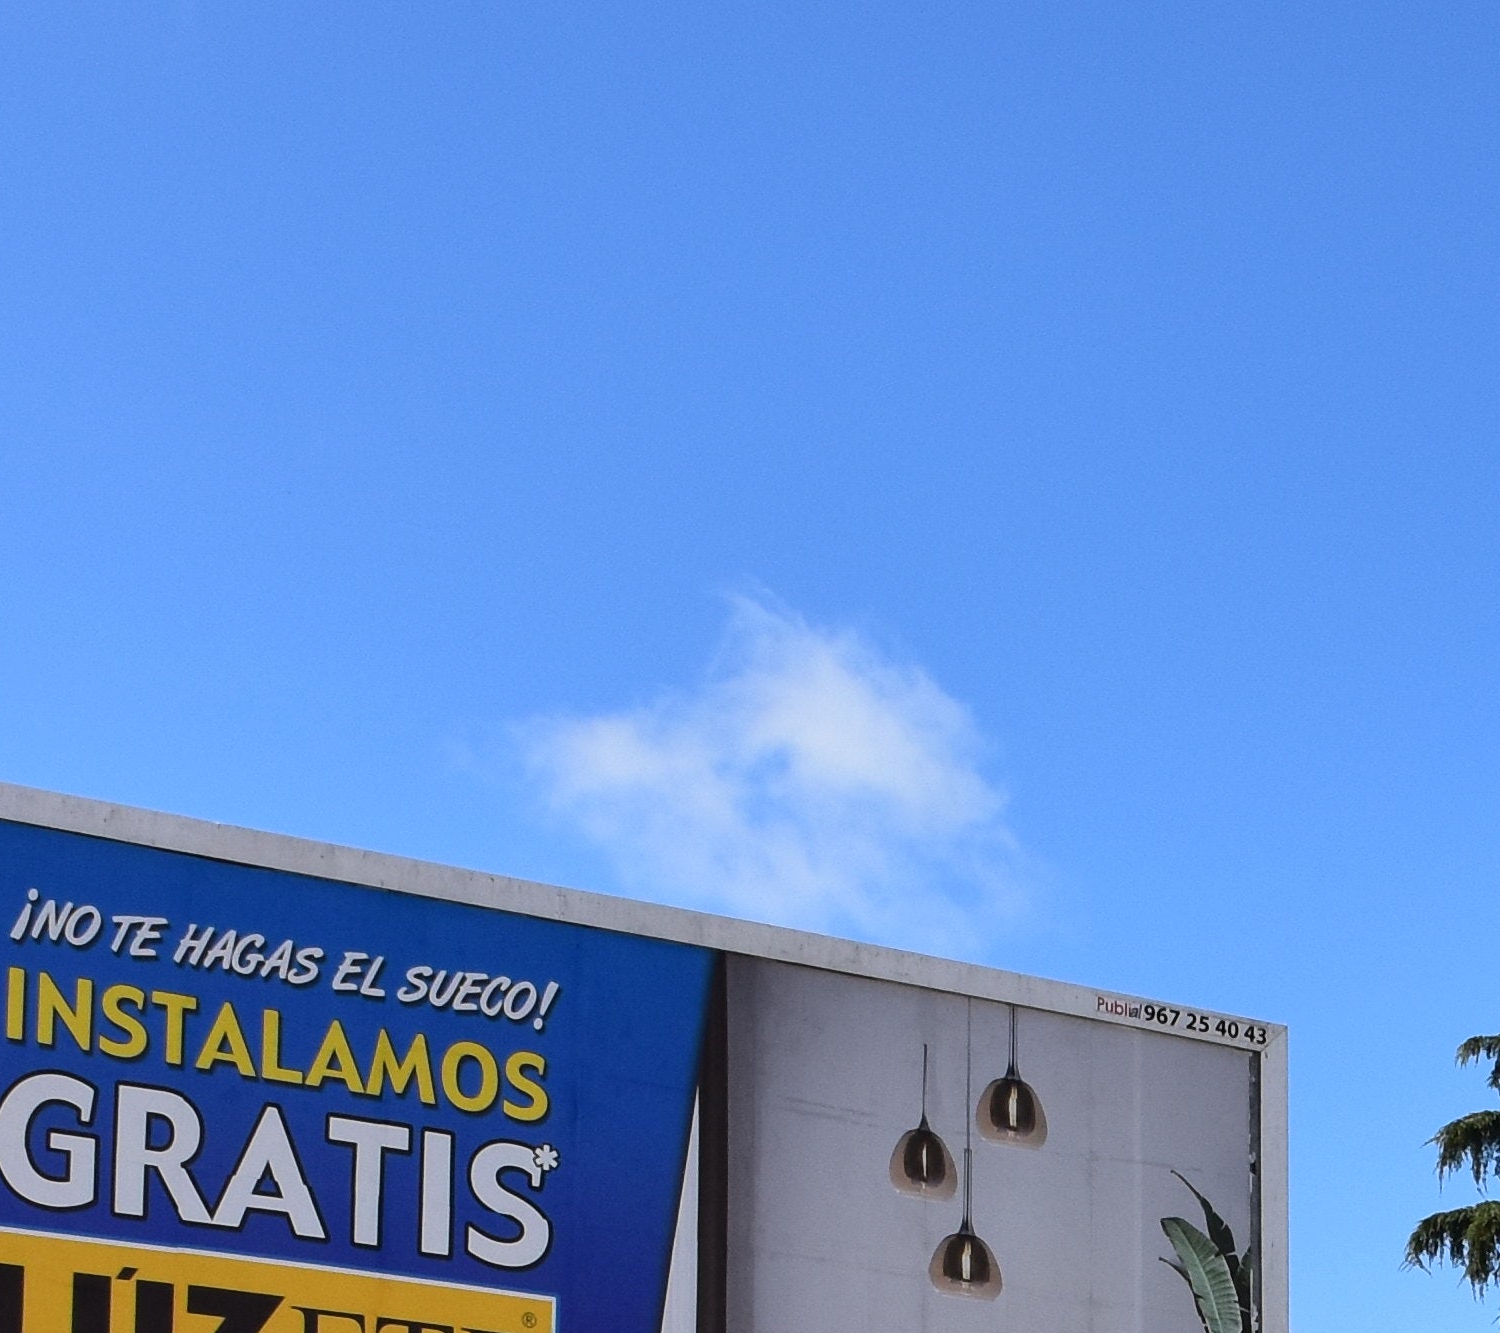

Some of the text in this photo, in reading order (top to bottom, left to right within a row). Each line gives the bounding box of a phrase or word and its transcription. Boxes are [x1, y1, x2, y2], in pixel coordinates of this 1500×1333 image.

[9, 886, 561, 1031] ¡NO TE HAGAS EL SUECO!
[1144, 1004, 1180, 1027] 967
[1186, 1012, 1210, 1033] 25
[1215, 1019, 1239, 1039] 40
[1244, 1025, 1268, 1045] 43
[4, 966, 550, 1123] INSTALAMOS
